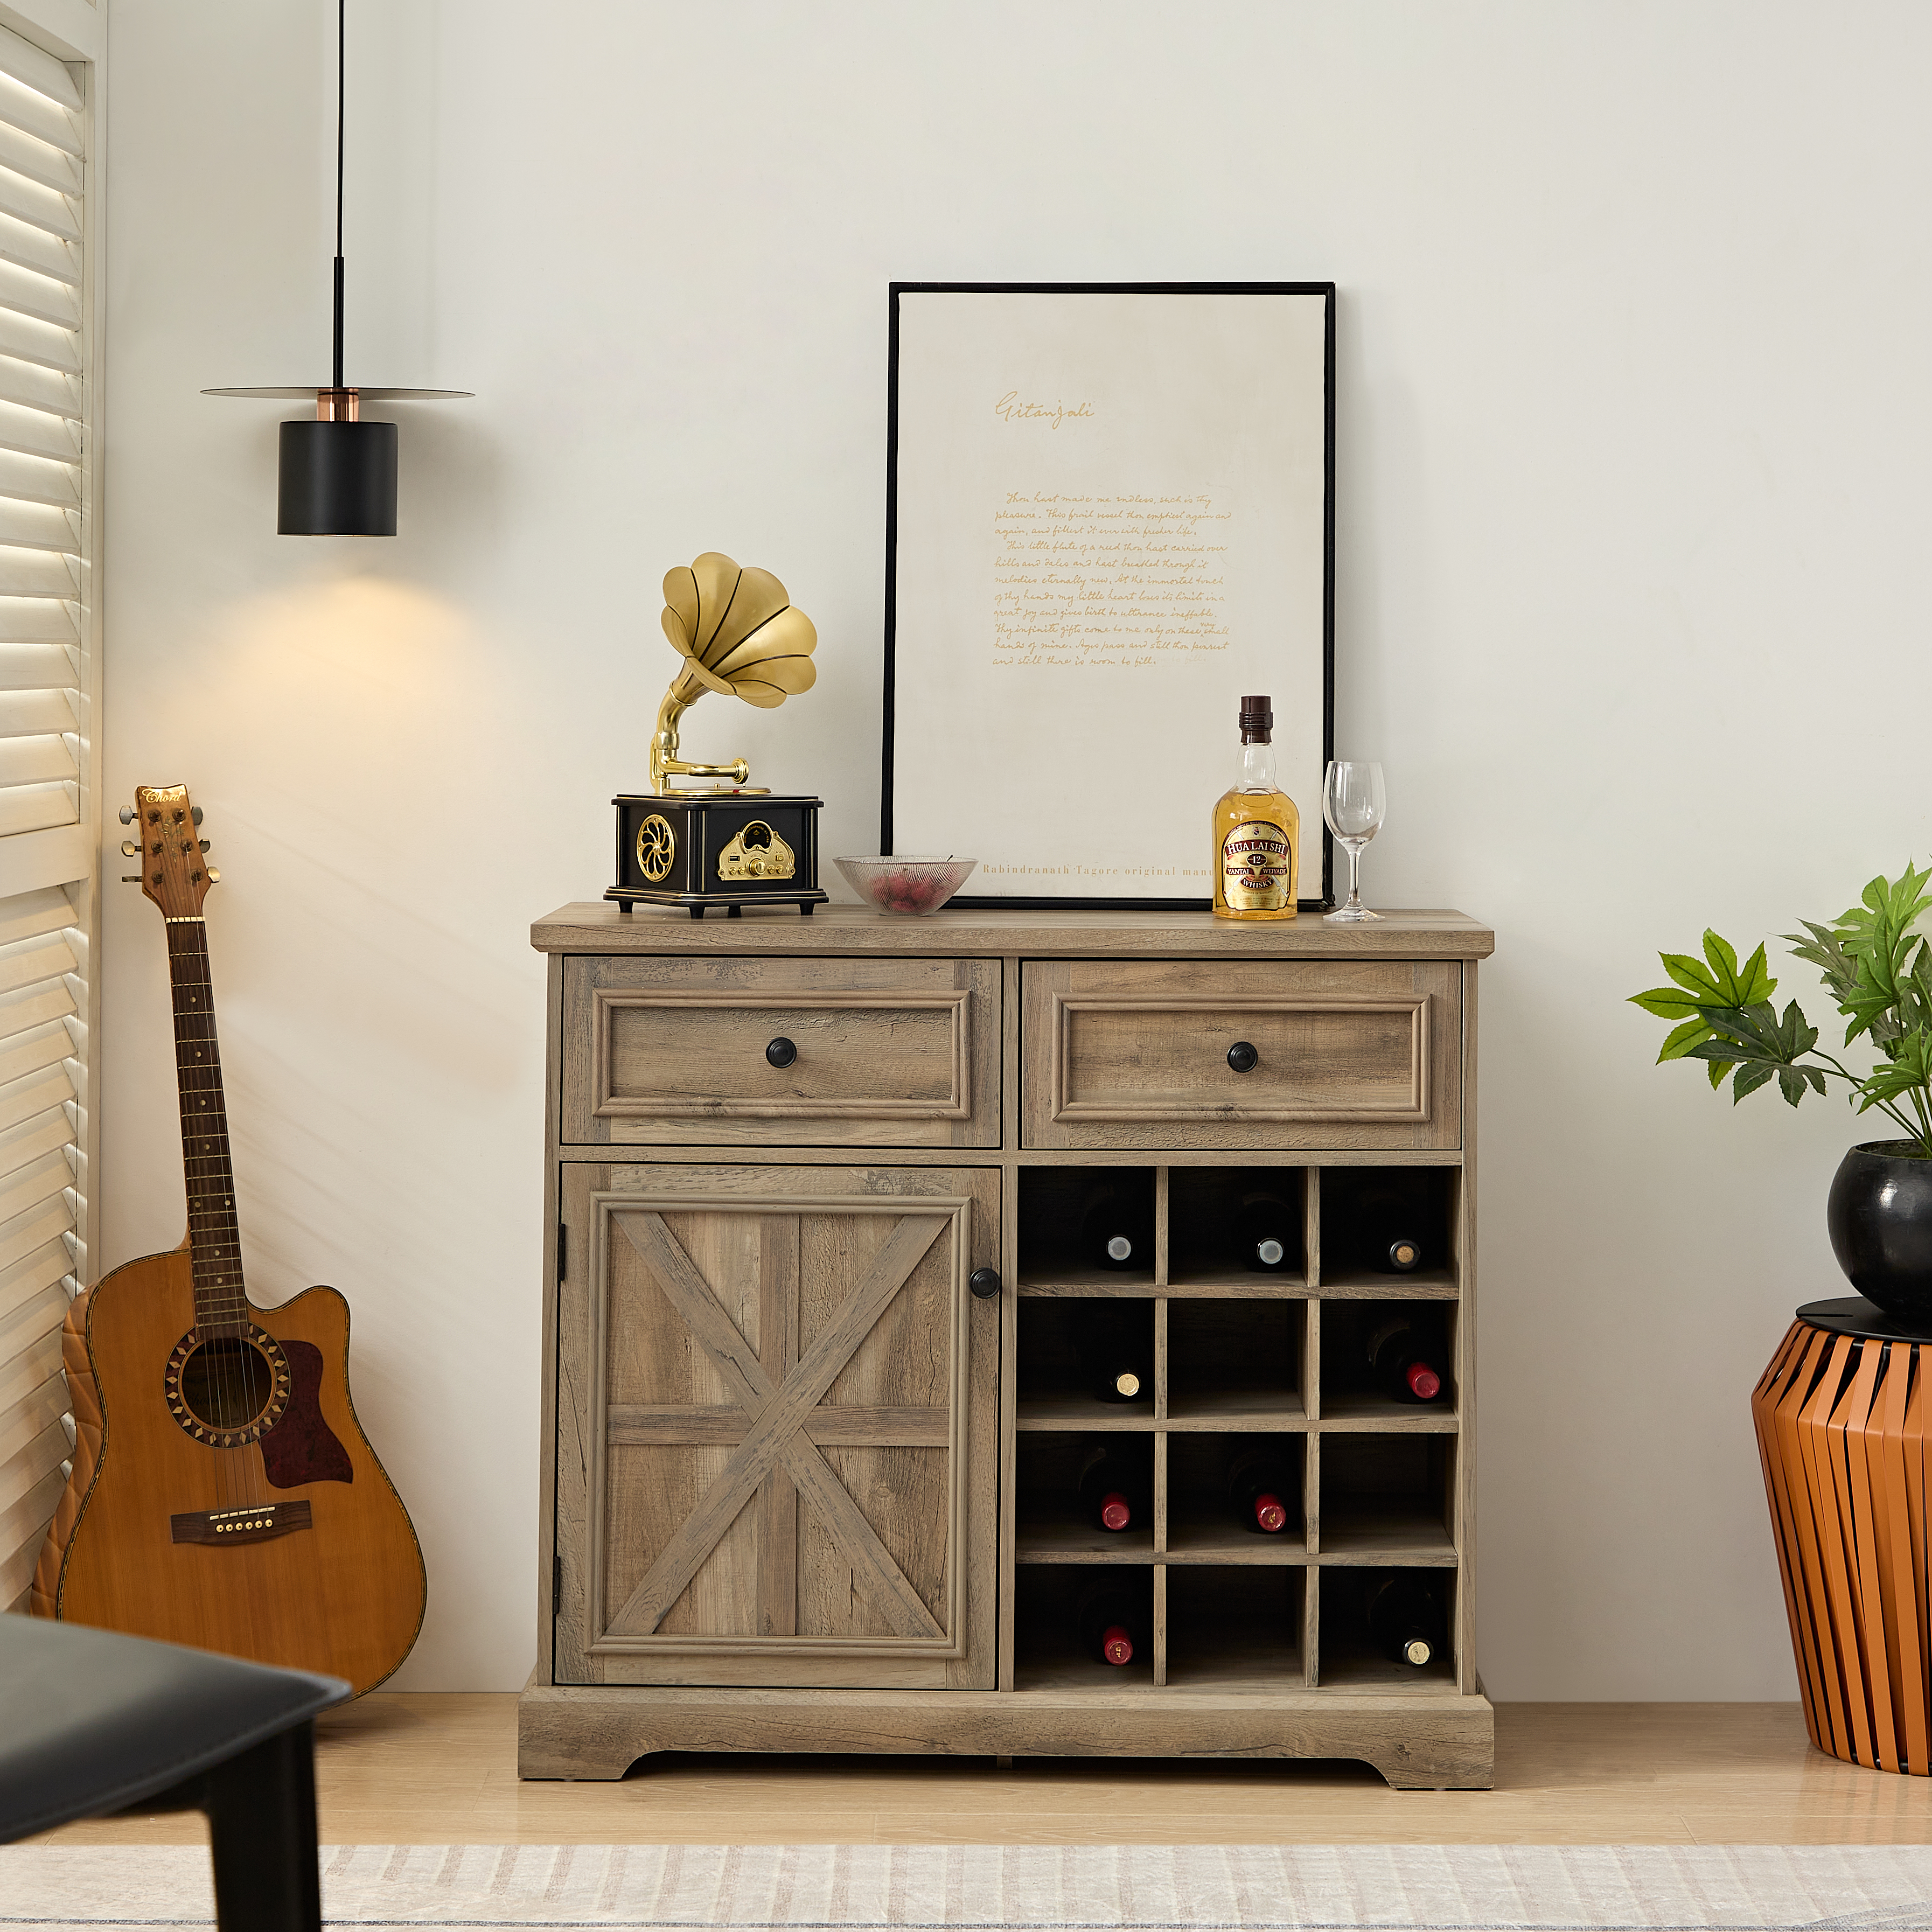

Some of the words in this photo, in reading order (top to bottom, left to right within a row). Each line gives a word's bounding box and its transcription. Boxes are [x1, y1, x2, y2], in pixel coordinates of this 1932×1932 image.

[995, 390, 1095, 430] Gitanjali
[1006, 491, 1029, 504] Thou
[1034, 491, 1059, 503] hast
[1184, 494, 1193, 503] is
[1196, 494, 1212, 509] thy
[1046, 508, 1066, 518] This
[1068, 508, 1094, 521] frail
[1097, 510, 1122, 518] vessel
[1126, 511, 1144, 519] thou
[1147, 511, 1185, 523] emptiest
[1186, 511, 1213, 525] again
[1052, 525, 1084, 537] fillest
[1087, 526, 1098, 534] it
[1121, 525, 1140, 534] with
[1143, 526, 1174, 538] fresher
[1006, 540, 1024, 550] This
[1028, 540, 1050, 549] little
[1052, 541, 1078, 553] flute
[1079, 545, 1087, 556] of
[1146, 542, 1168, 552] hast
[994, 556, 1020, 567] hills
[1044, 559, 1069, 567] dales
[1096, 557, 1118, 567] hast
[1121, 557, 1160, 567] breathed
[1162, 559, 1196, 573] through
[1197, 560, 1209, 569] it
[995, 575, 1037, 583] melodies
[1042, 574, 1087, 590] eternally
[1115, 574, 1129, 583] At
[1147, 576, 1193, 584] immortal
[1196, 575, 1224, 584] touch
[995, 594, 1002, 606] of
[1005, 591, 1020, 605] thy
[1023, 589, 1054, 599] hands
[1058, 595, 1073, 607] my
[1079, 591, 1104, 600] little
[1107, 589, 1136, 600] heart
[1139, 590, 1159, 601] loses
[1162, 591, 1173, 601] its
[1175, 591, 1204, 600] limits
[1205, 592, 1217, 601] in
[994, 607, 1022, 622] great
[1022, 609, 1036, 622] joy
[1060, 609, 1082, 619] gives
[1085, 606, 1106, 616] birth
[1109, 608, 1118, 616] to
[995, 623, 1013, 639] Thy
[1015, 623, 1059, 636] infinite
[1061, 624, 1082, 638] gifts
[1145, 625, 1163, 640] only
[1204, 626, 1230, 635] small
[994, 637, 1024, 649] hands
[1028, 642, 1036, 654] of
[1076, 638, 1099, 655] Ages
[1100, 641, 1125, 652] pass
[1150, 641, 1171, 649] still
[1173, 641, 1189, 649] thou
[1018, 655, 1042, 664] still
[1047, 656, 1072, 664] there
[1075, 656, 1084, 665] is
[142, 789, 182, 803] Chord
[1227, 842, 1250, 854] HUA
[1251, 841, 1268, 850] LAI
[1270, 842, 1286, 854] SHI
[1252, 855, 1261, 864] 12
[983, 864, 1070, 875] Rabindranath
[1076, 864, 1118, 877] Tagore
[1125, 866, 1176, 877] original
[1243, 878, 1272, 888] WHISKY
